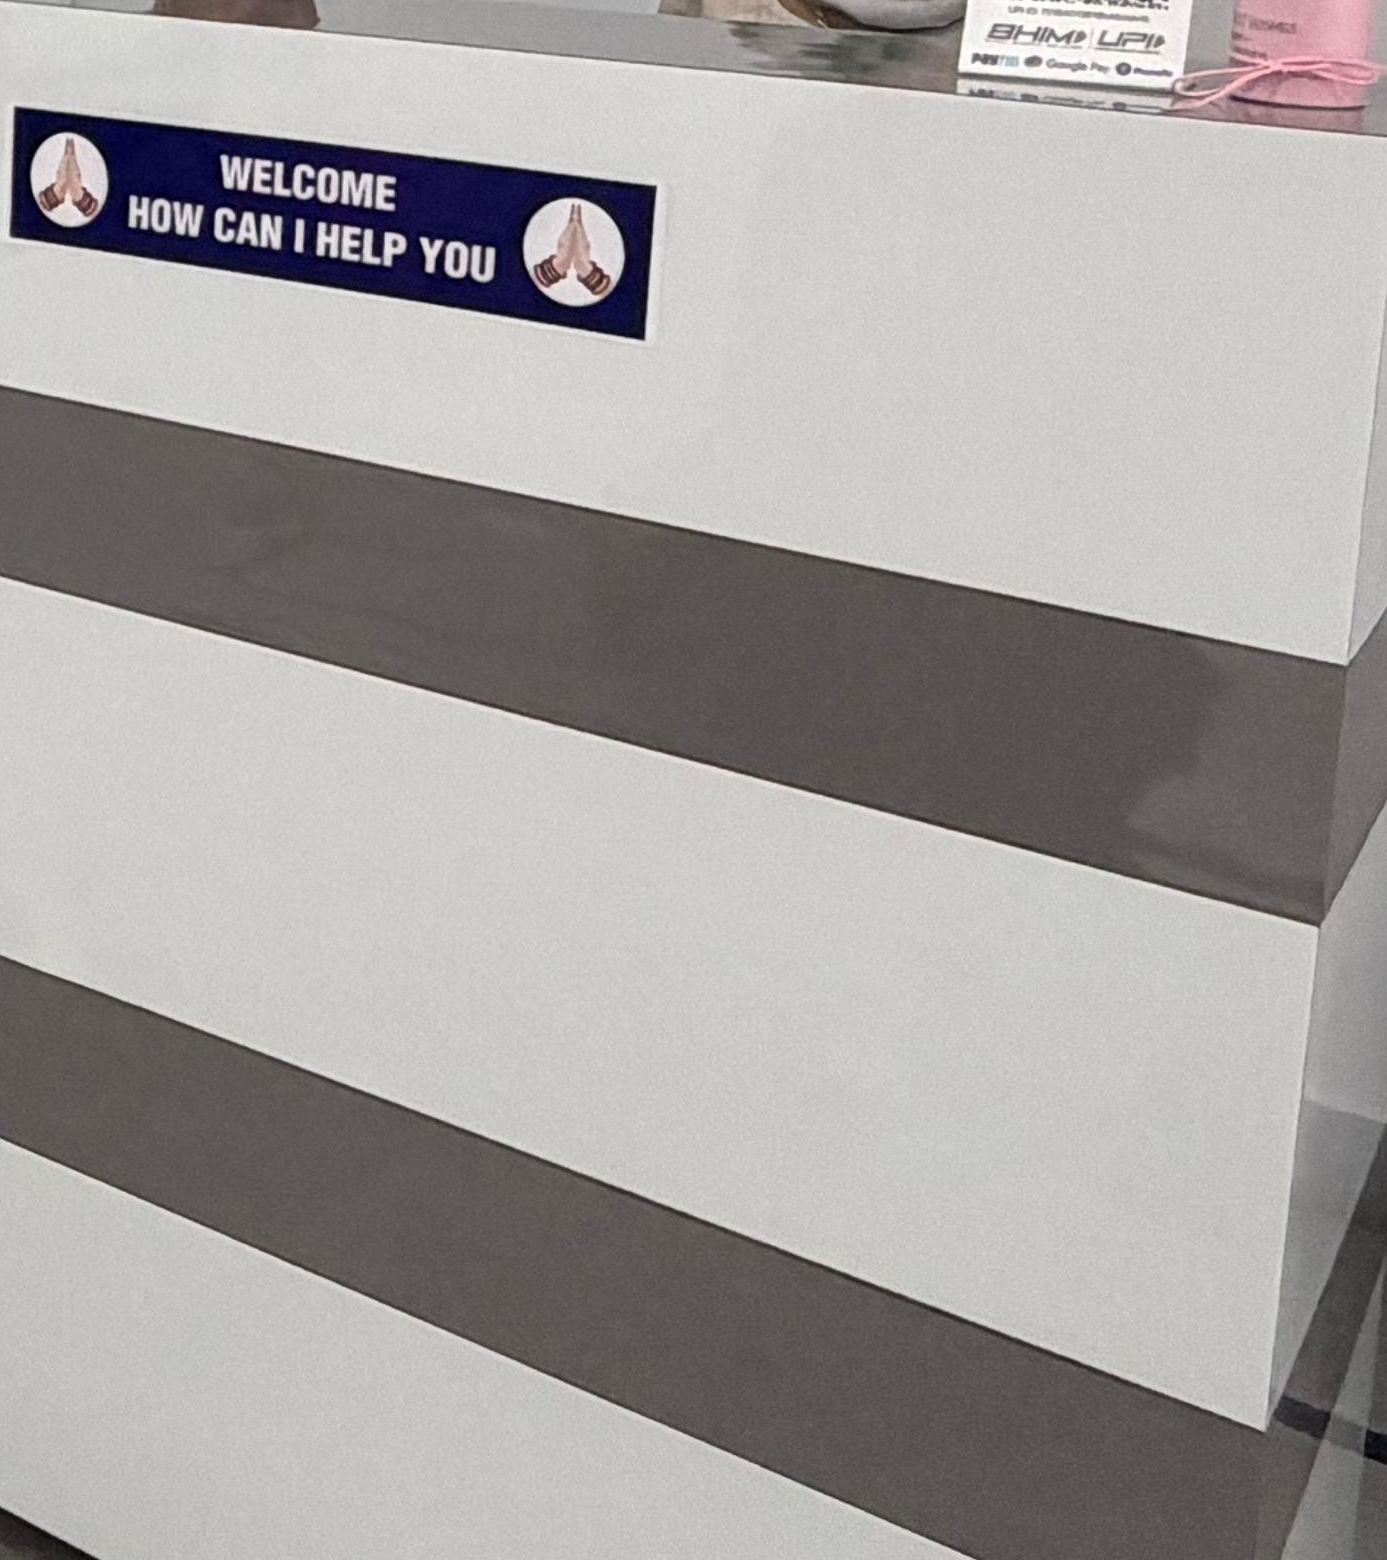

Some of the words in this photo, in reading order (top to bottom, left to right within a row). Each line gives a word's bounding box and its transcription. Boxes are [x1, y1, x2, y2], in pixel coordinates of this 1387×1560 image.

[987, 23, 1076, 46] BHIM
[1097, 30, 1157, 48] UPI
[220, 154, 396, 212] WELCOME
[128, 195, 204, 237] HOW
[213, 207, 283, 249] CAN
[294, 219, 304, 253] I
[315, 222, 407, 268] HELP
[419, 237, 495, 283] YOU
